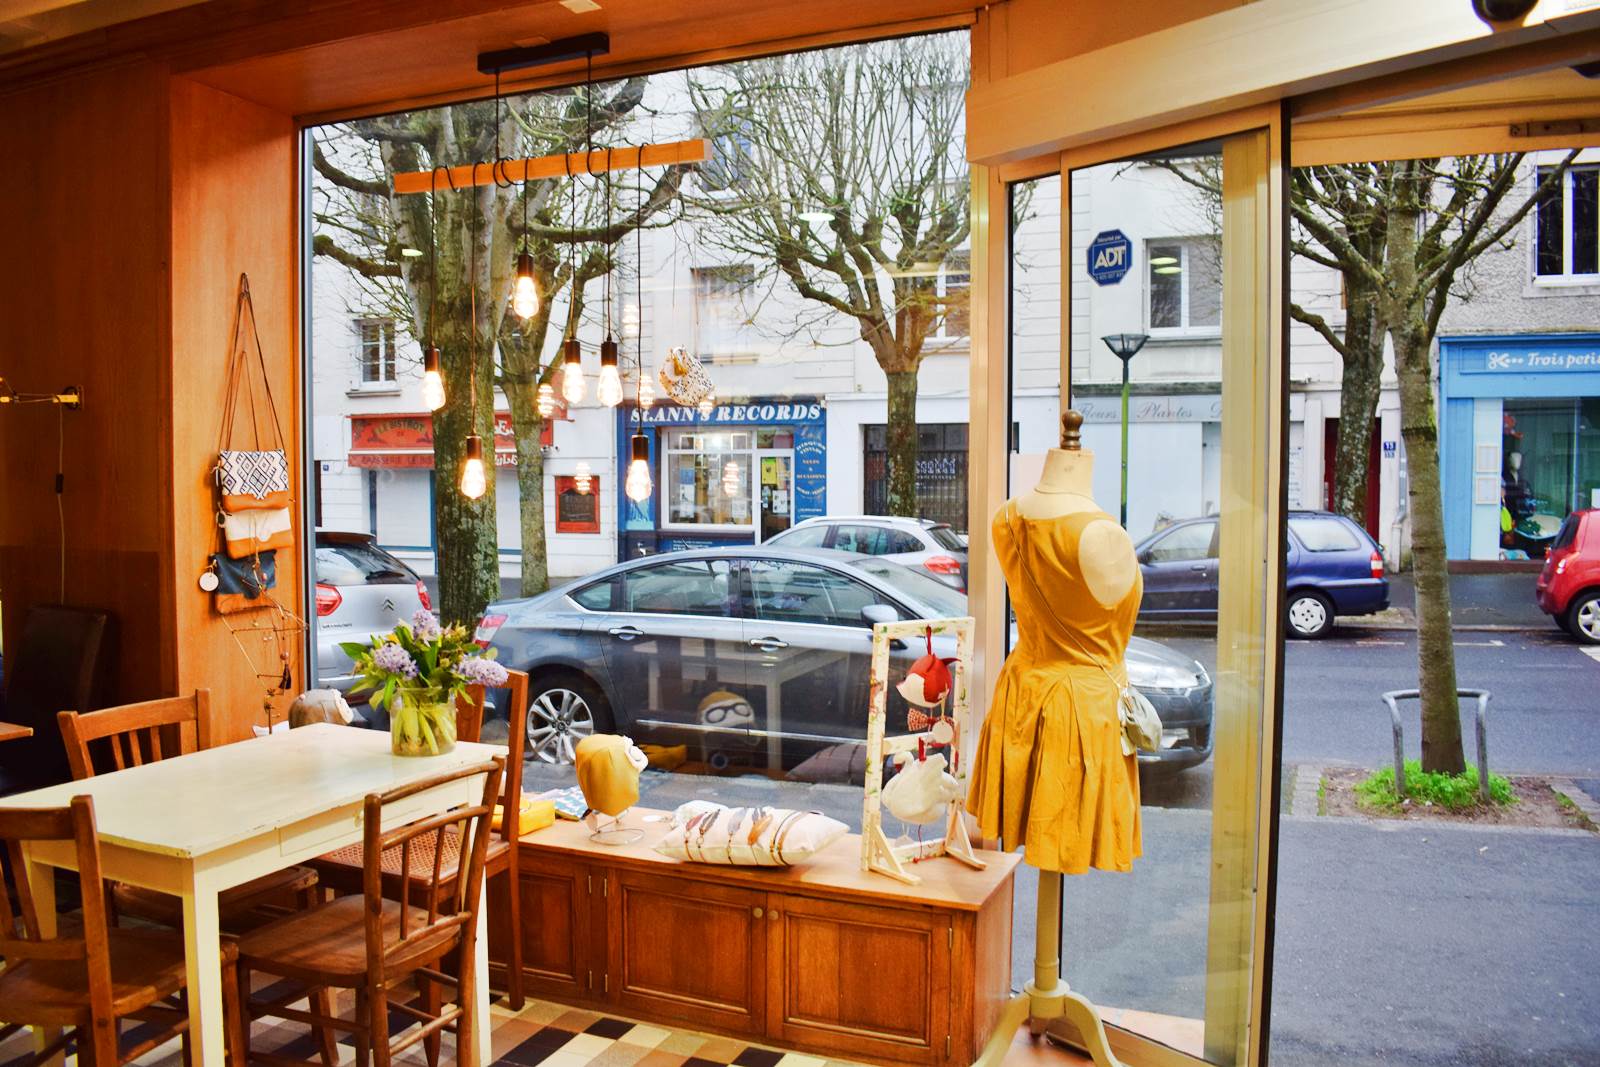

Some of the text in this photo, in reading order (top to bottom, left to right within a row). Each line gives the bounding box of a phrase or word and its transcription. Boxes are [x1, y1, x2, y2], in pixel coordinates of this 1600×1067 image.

[1094, 246, 1126, 269] ADT
[1527, 352, 1565, 367] Trois
[716, 404, 821, 421] RECORDS
[1137, 401, 1193, 419] Plantes
